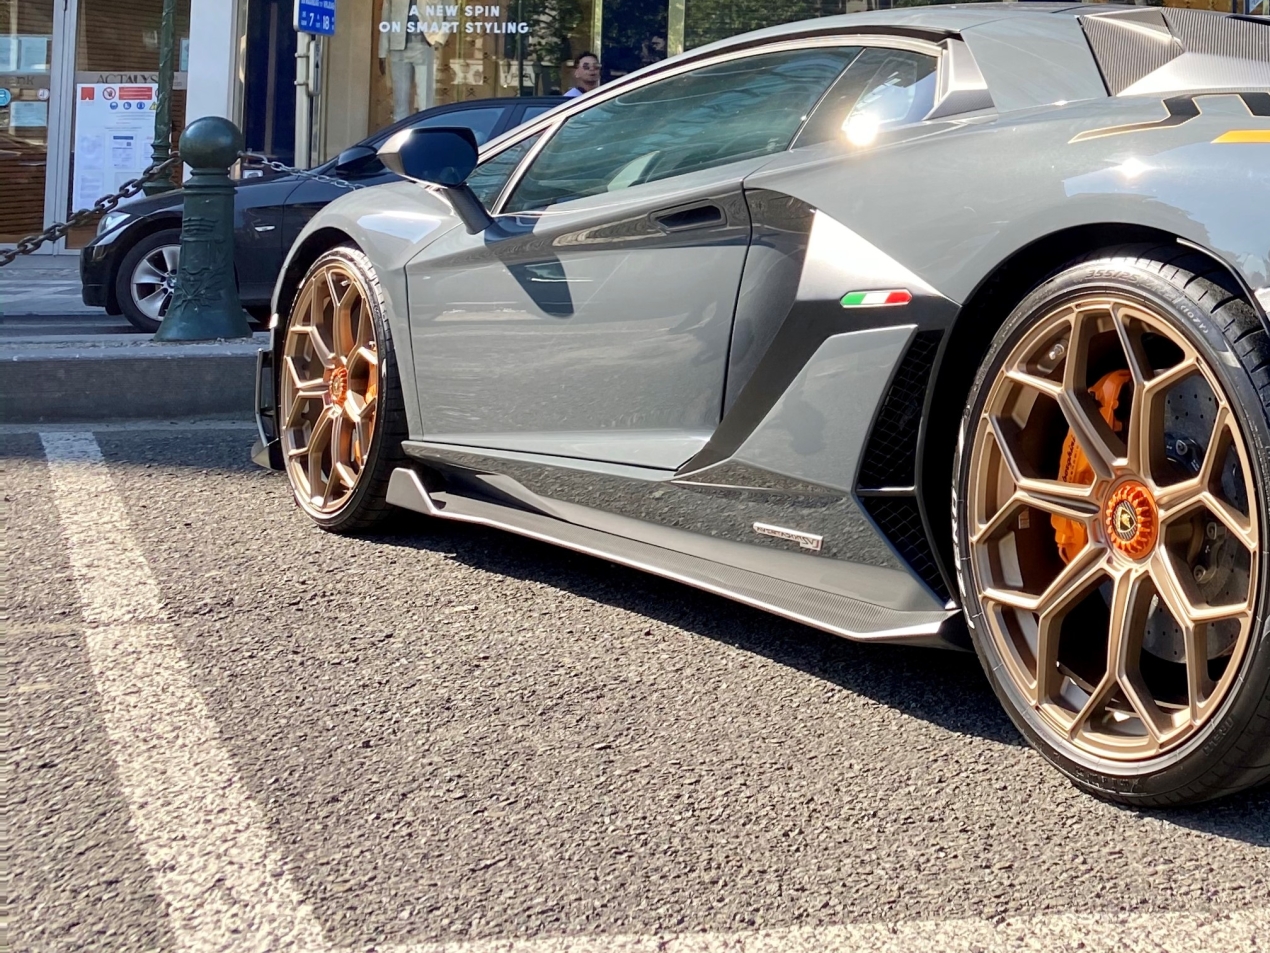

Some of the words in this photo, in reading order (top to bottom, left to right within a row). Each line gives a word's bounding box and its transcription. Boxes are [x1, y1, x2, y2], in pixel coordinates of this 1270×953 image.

[409, 5, 419, 16] A
[426, 5, 459, 17] NEW
[465, 6, 500, 17] SPIN
[309, 12, 315, 27] 7
[379, 22, 401, 33] ON
[407, 22, 459, 33] SMART
[465, 22, 529, 33] STYLING
